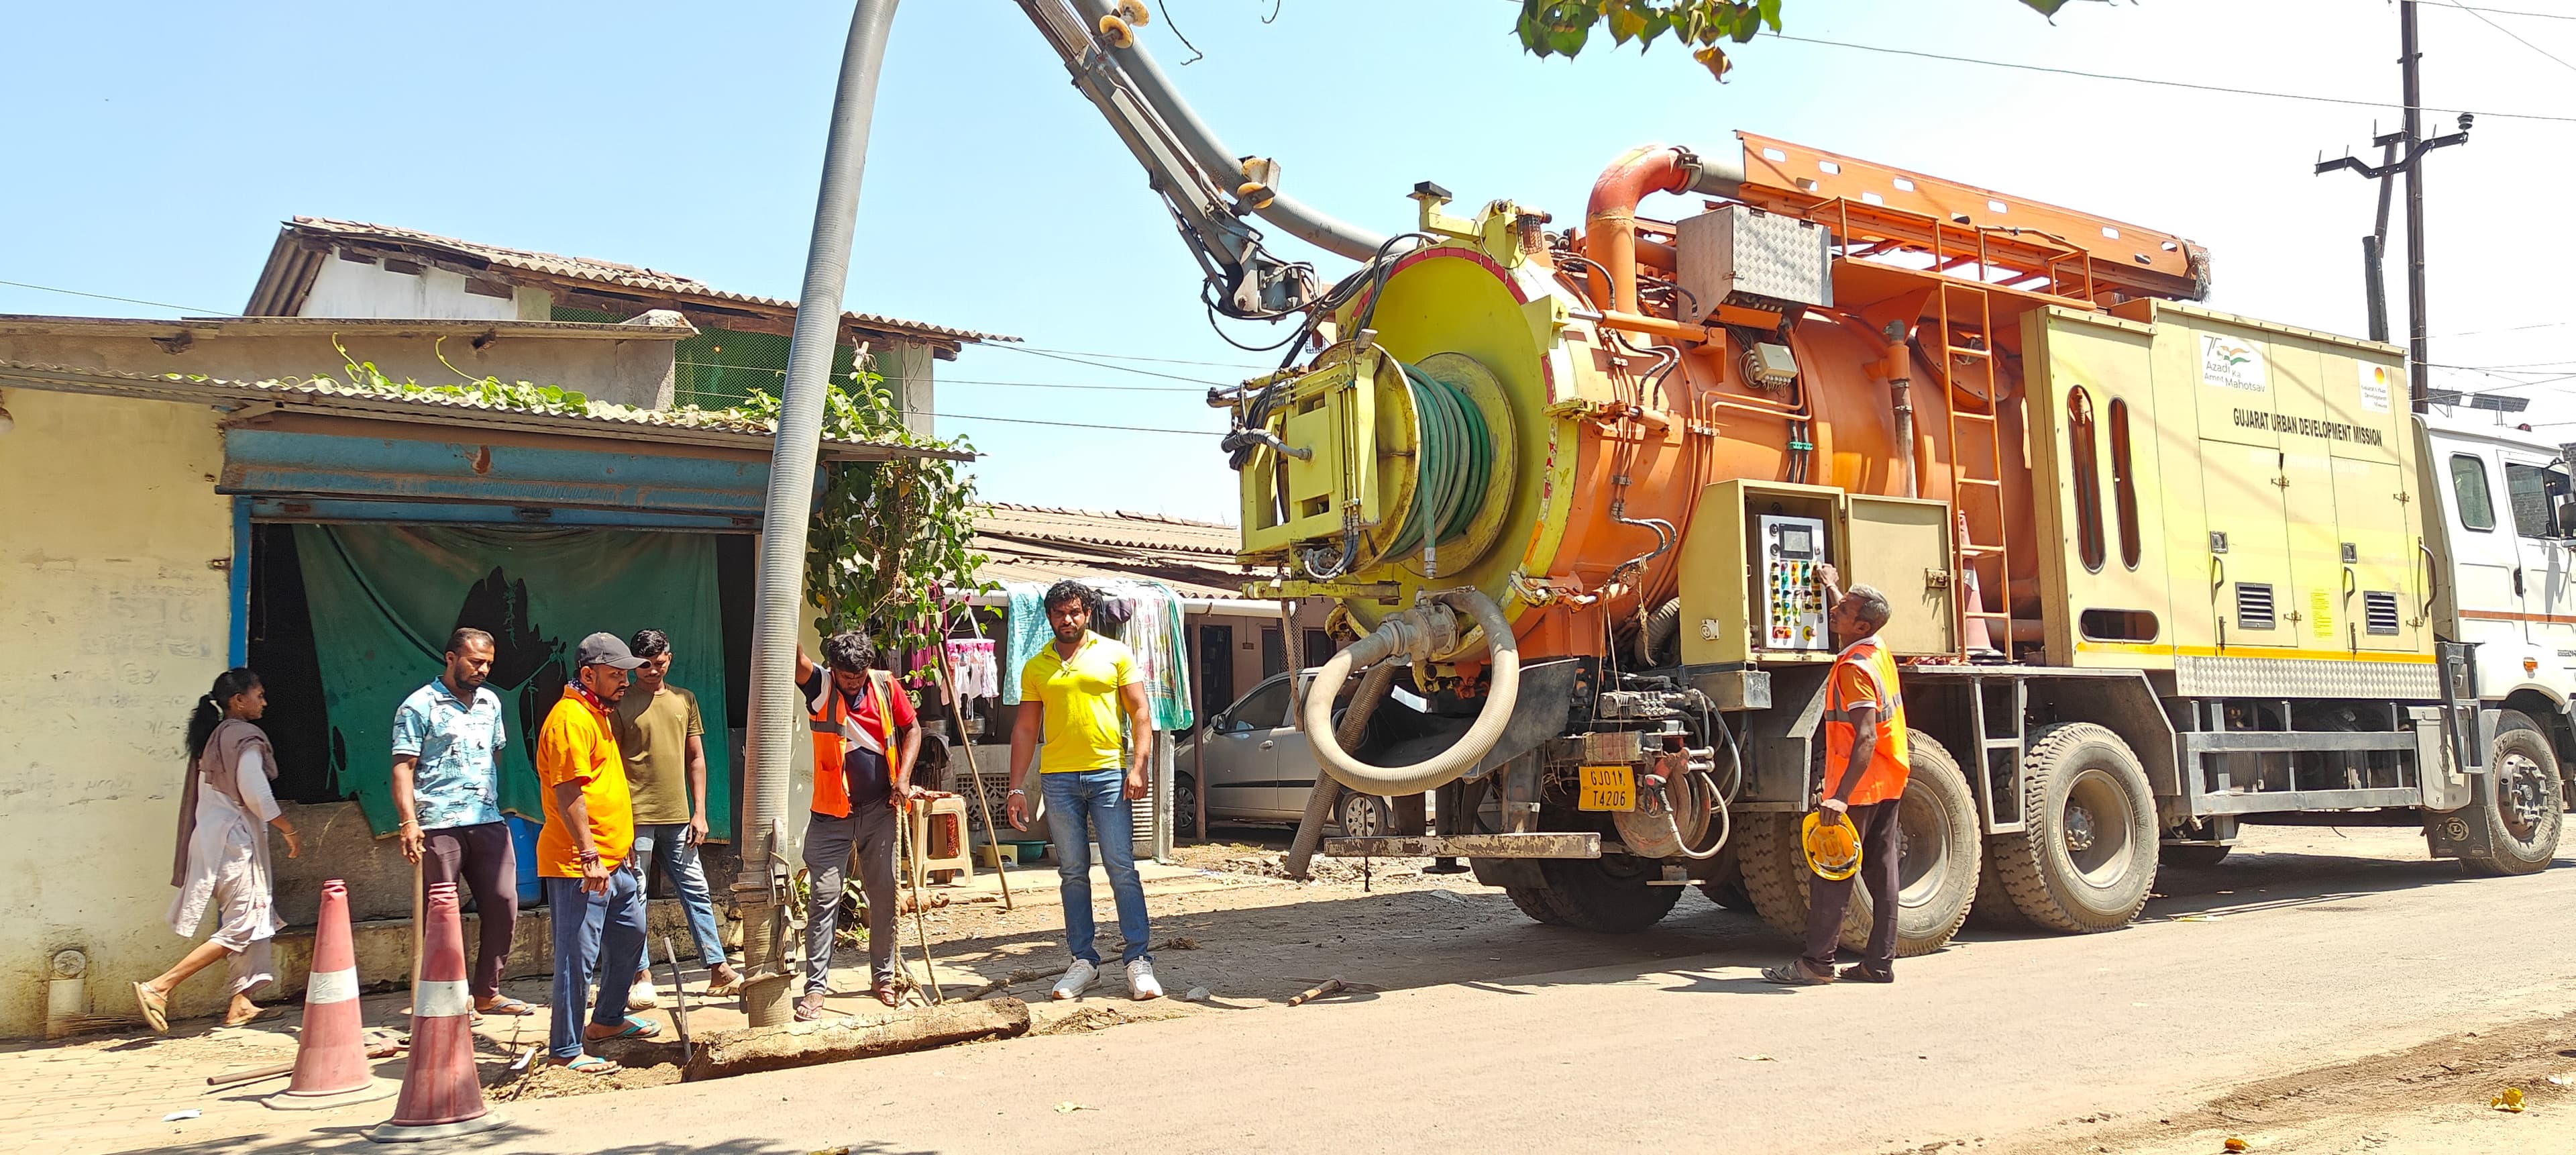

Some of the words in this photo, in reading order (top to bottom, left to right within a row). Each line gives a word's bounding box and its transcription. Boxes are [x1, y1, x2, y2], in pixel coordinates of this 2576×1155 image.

[2206, 361, 2231, 374] Azadi
[2225, 377, 2265, 393] Mahotsav
[2233, 407, 2269, 430] GUJARAT
[2271, 413, 2298, 434] URBAN
[2299, 417, 2351, 442] DEVELOPMENT
[2353, 425, 2383, 447] MISSION
[1593, 791, 1625, 807] T4206
